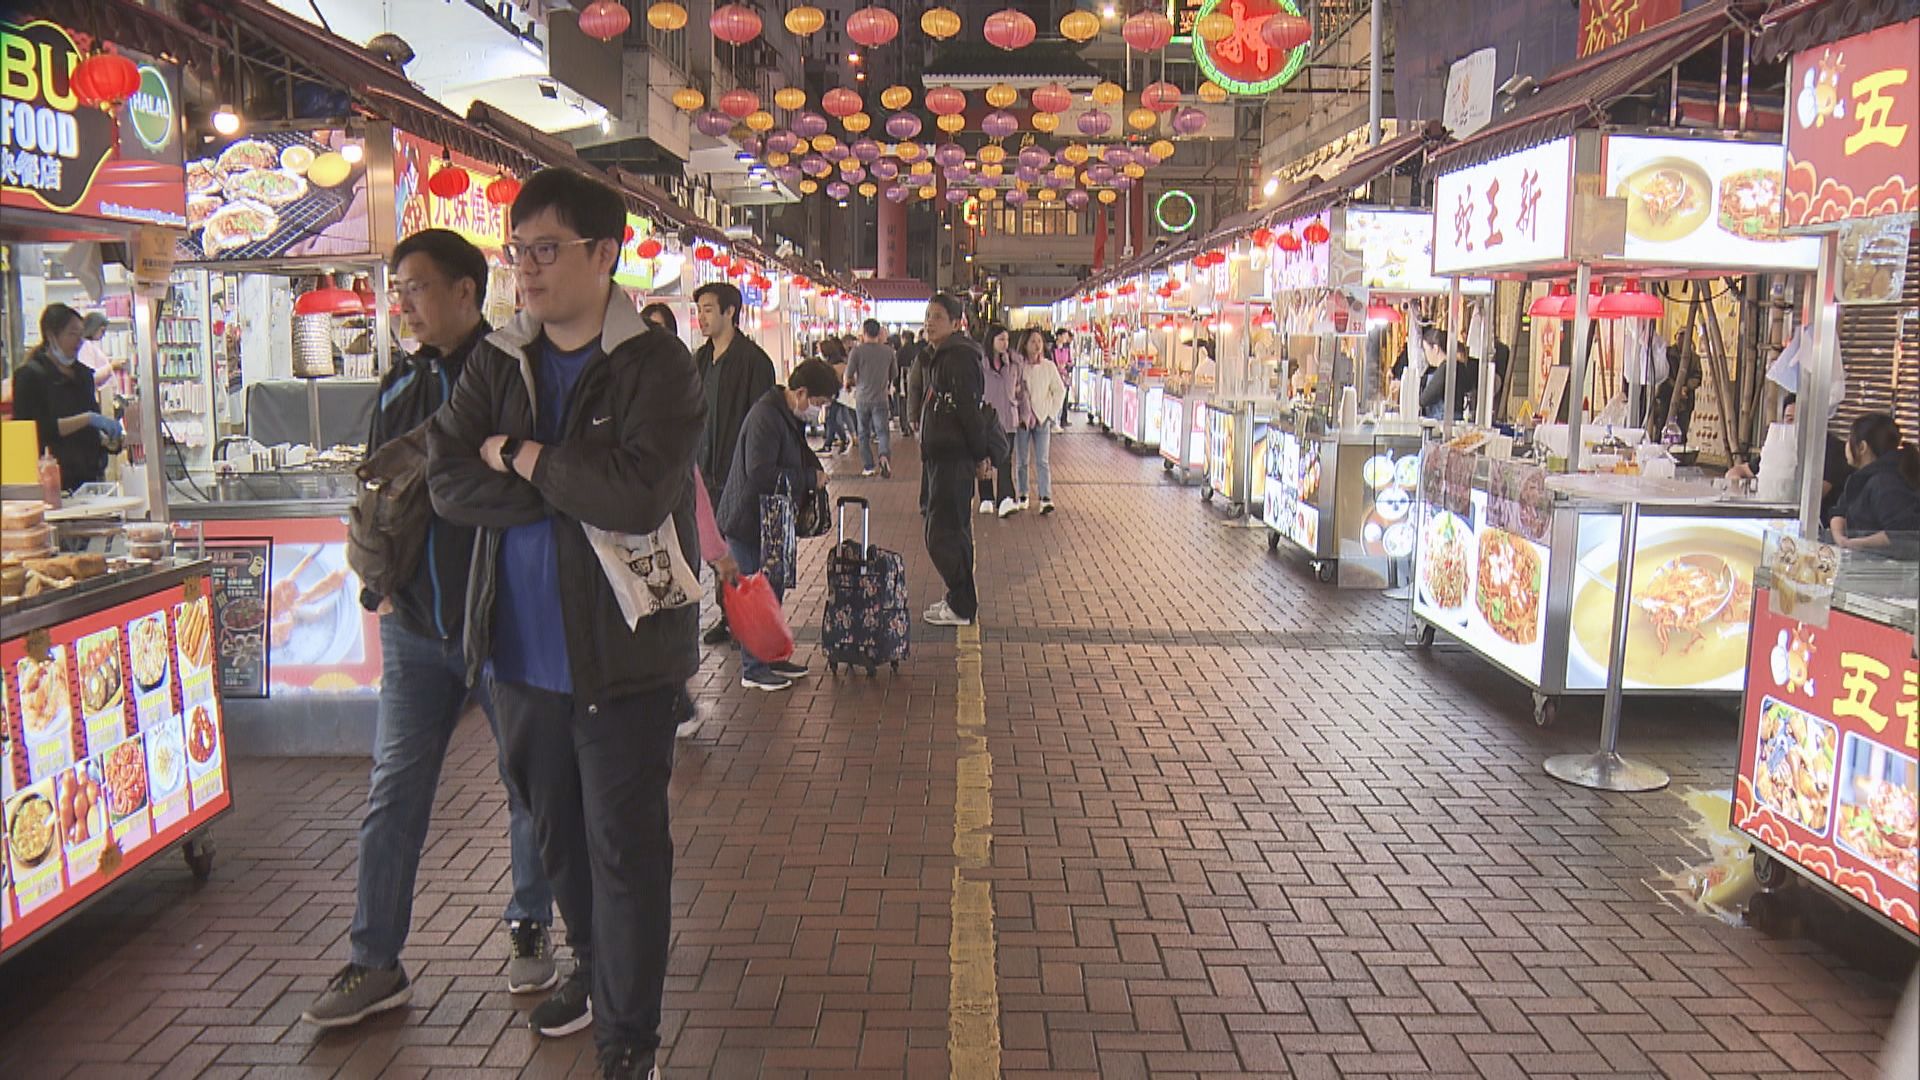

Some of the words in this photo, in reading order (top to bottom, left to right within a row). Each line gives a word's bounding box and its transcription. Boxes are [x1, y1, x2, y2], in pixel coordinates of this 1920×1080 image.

[1, 98, 79, 158] FOOD
[132, 91, 170, 119] HALAL
[1844, 68, 1908, 156] 五
